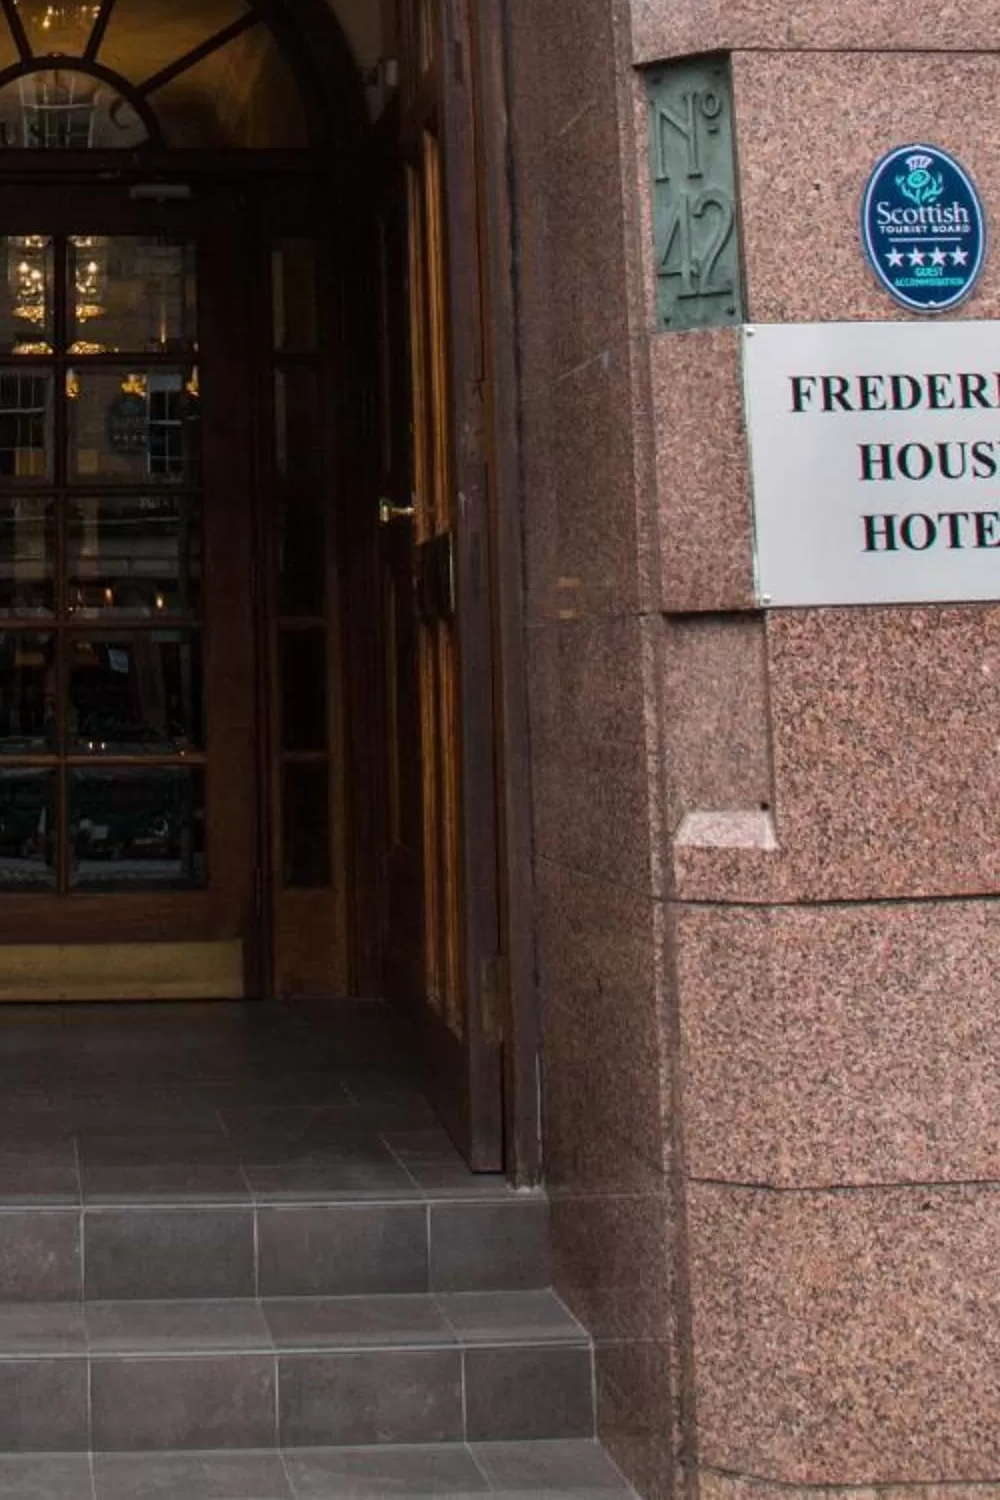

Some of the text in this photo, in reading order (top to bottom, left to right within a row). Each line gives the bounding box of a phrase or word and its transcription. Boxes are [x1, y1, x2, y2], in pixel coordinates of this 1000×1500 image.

[876, 201, 969, 225] Scottish
[880, 224, 971, 234] TOURIST BOARD
[656, 189, 735, 301] 42
[856, 440, 1000, 481] HOUS
